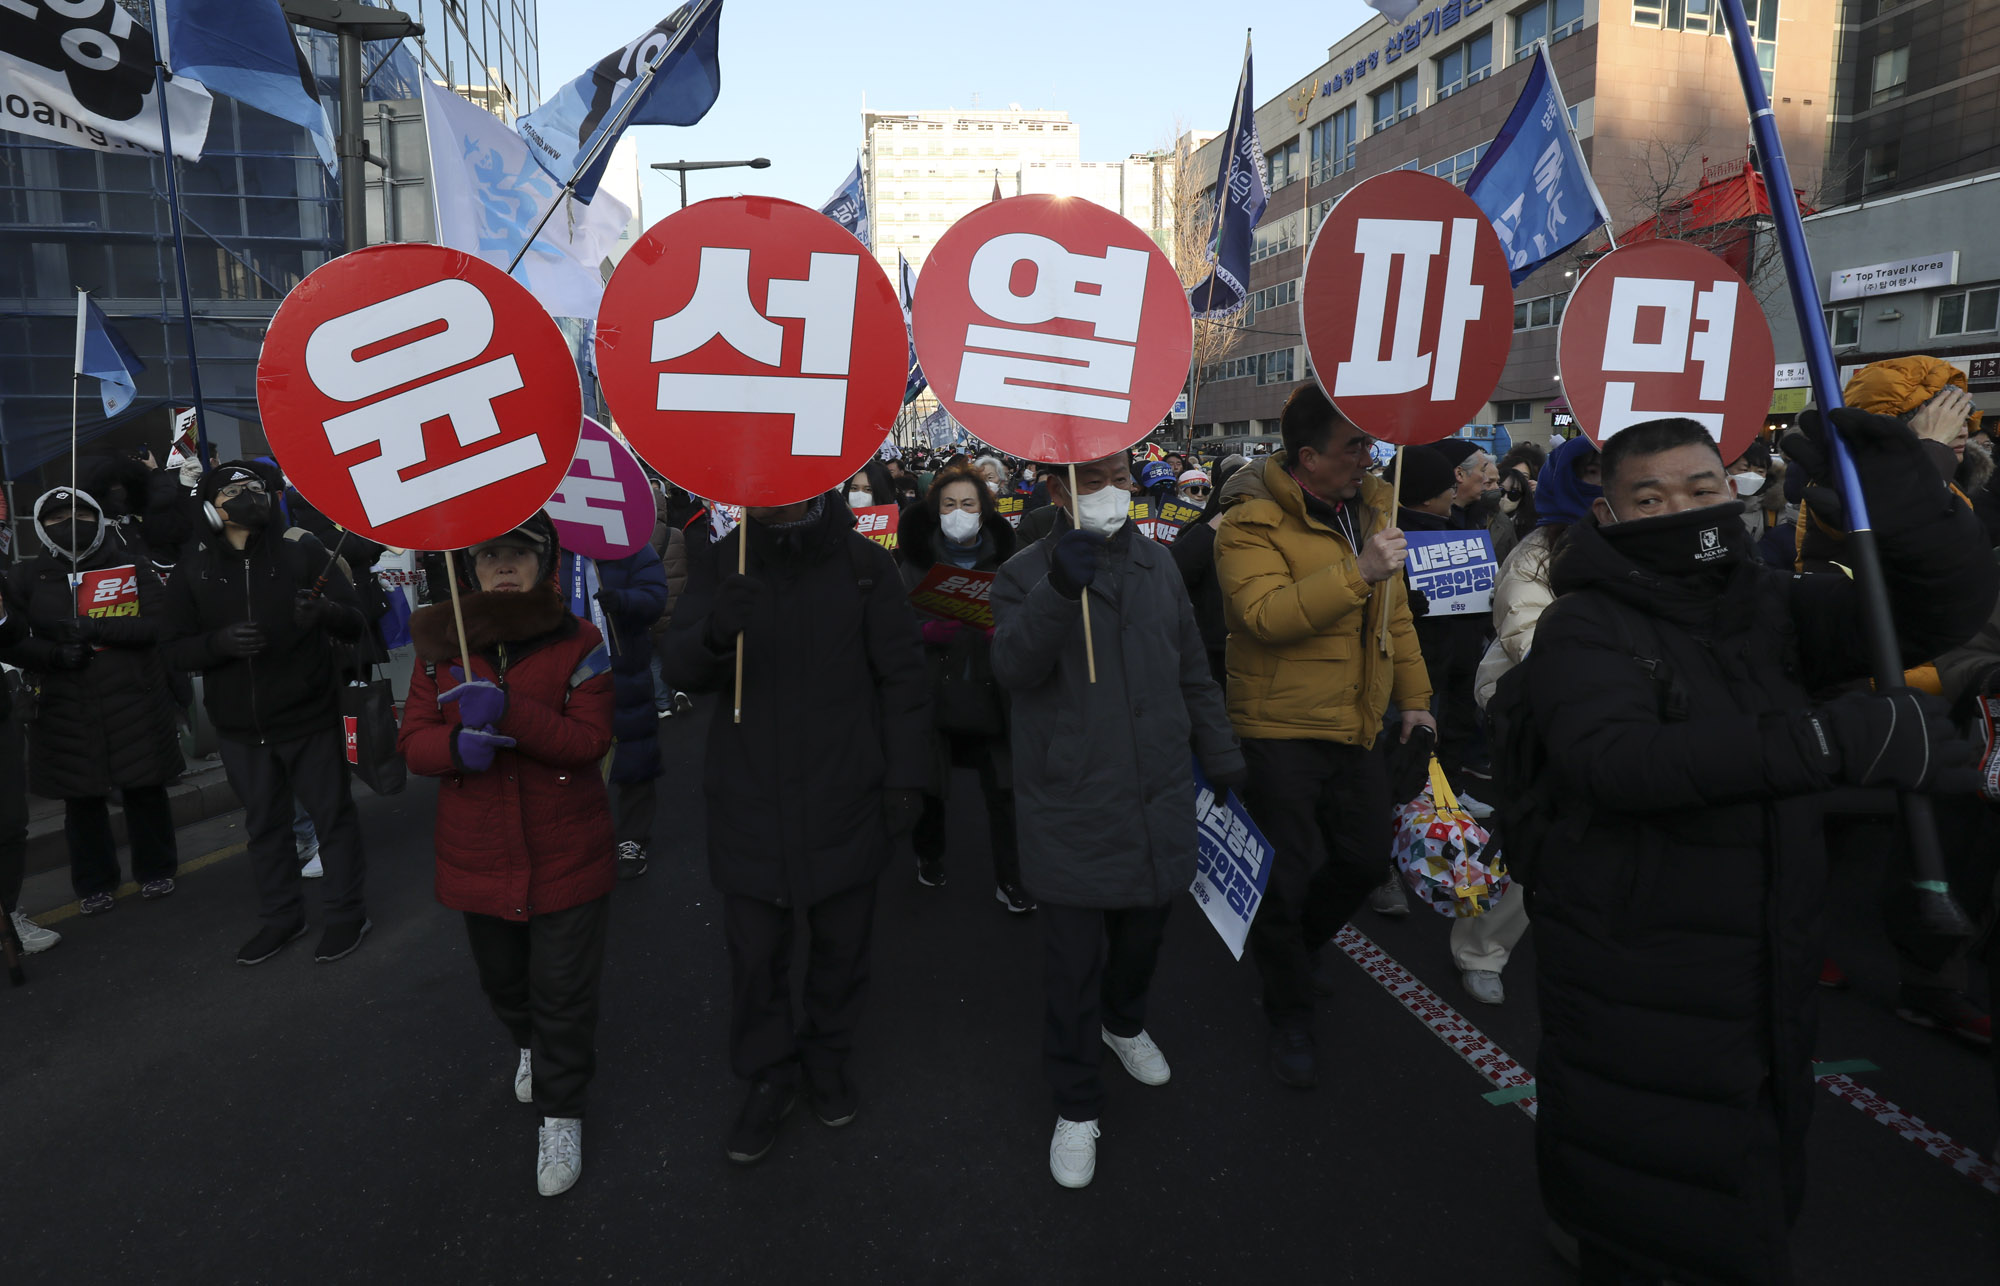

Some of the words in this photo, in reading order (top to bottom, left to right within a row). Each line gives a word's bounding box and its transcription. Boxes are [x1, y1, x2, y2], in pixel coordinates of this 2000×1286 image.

[1322, 50, 1379, 97] 서울경찰청
[651, 247, 859, 456] 석
[954, 233, 1149, 423] 열
[1334, 217, 1484, 401] 파
[1856, 273, 1873, 282] Top
[1876, 265, 1908, 278] Travel
[1911, 261, 1944, 273] Korea
[306, 278, 546, 527] 윤
[1597, 277, 1739, 443] 면
[1408, 537, 1488, 573] 내란종식
